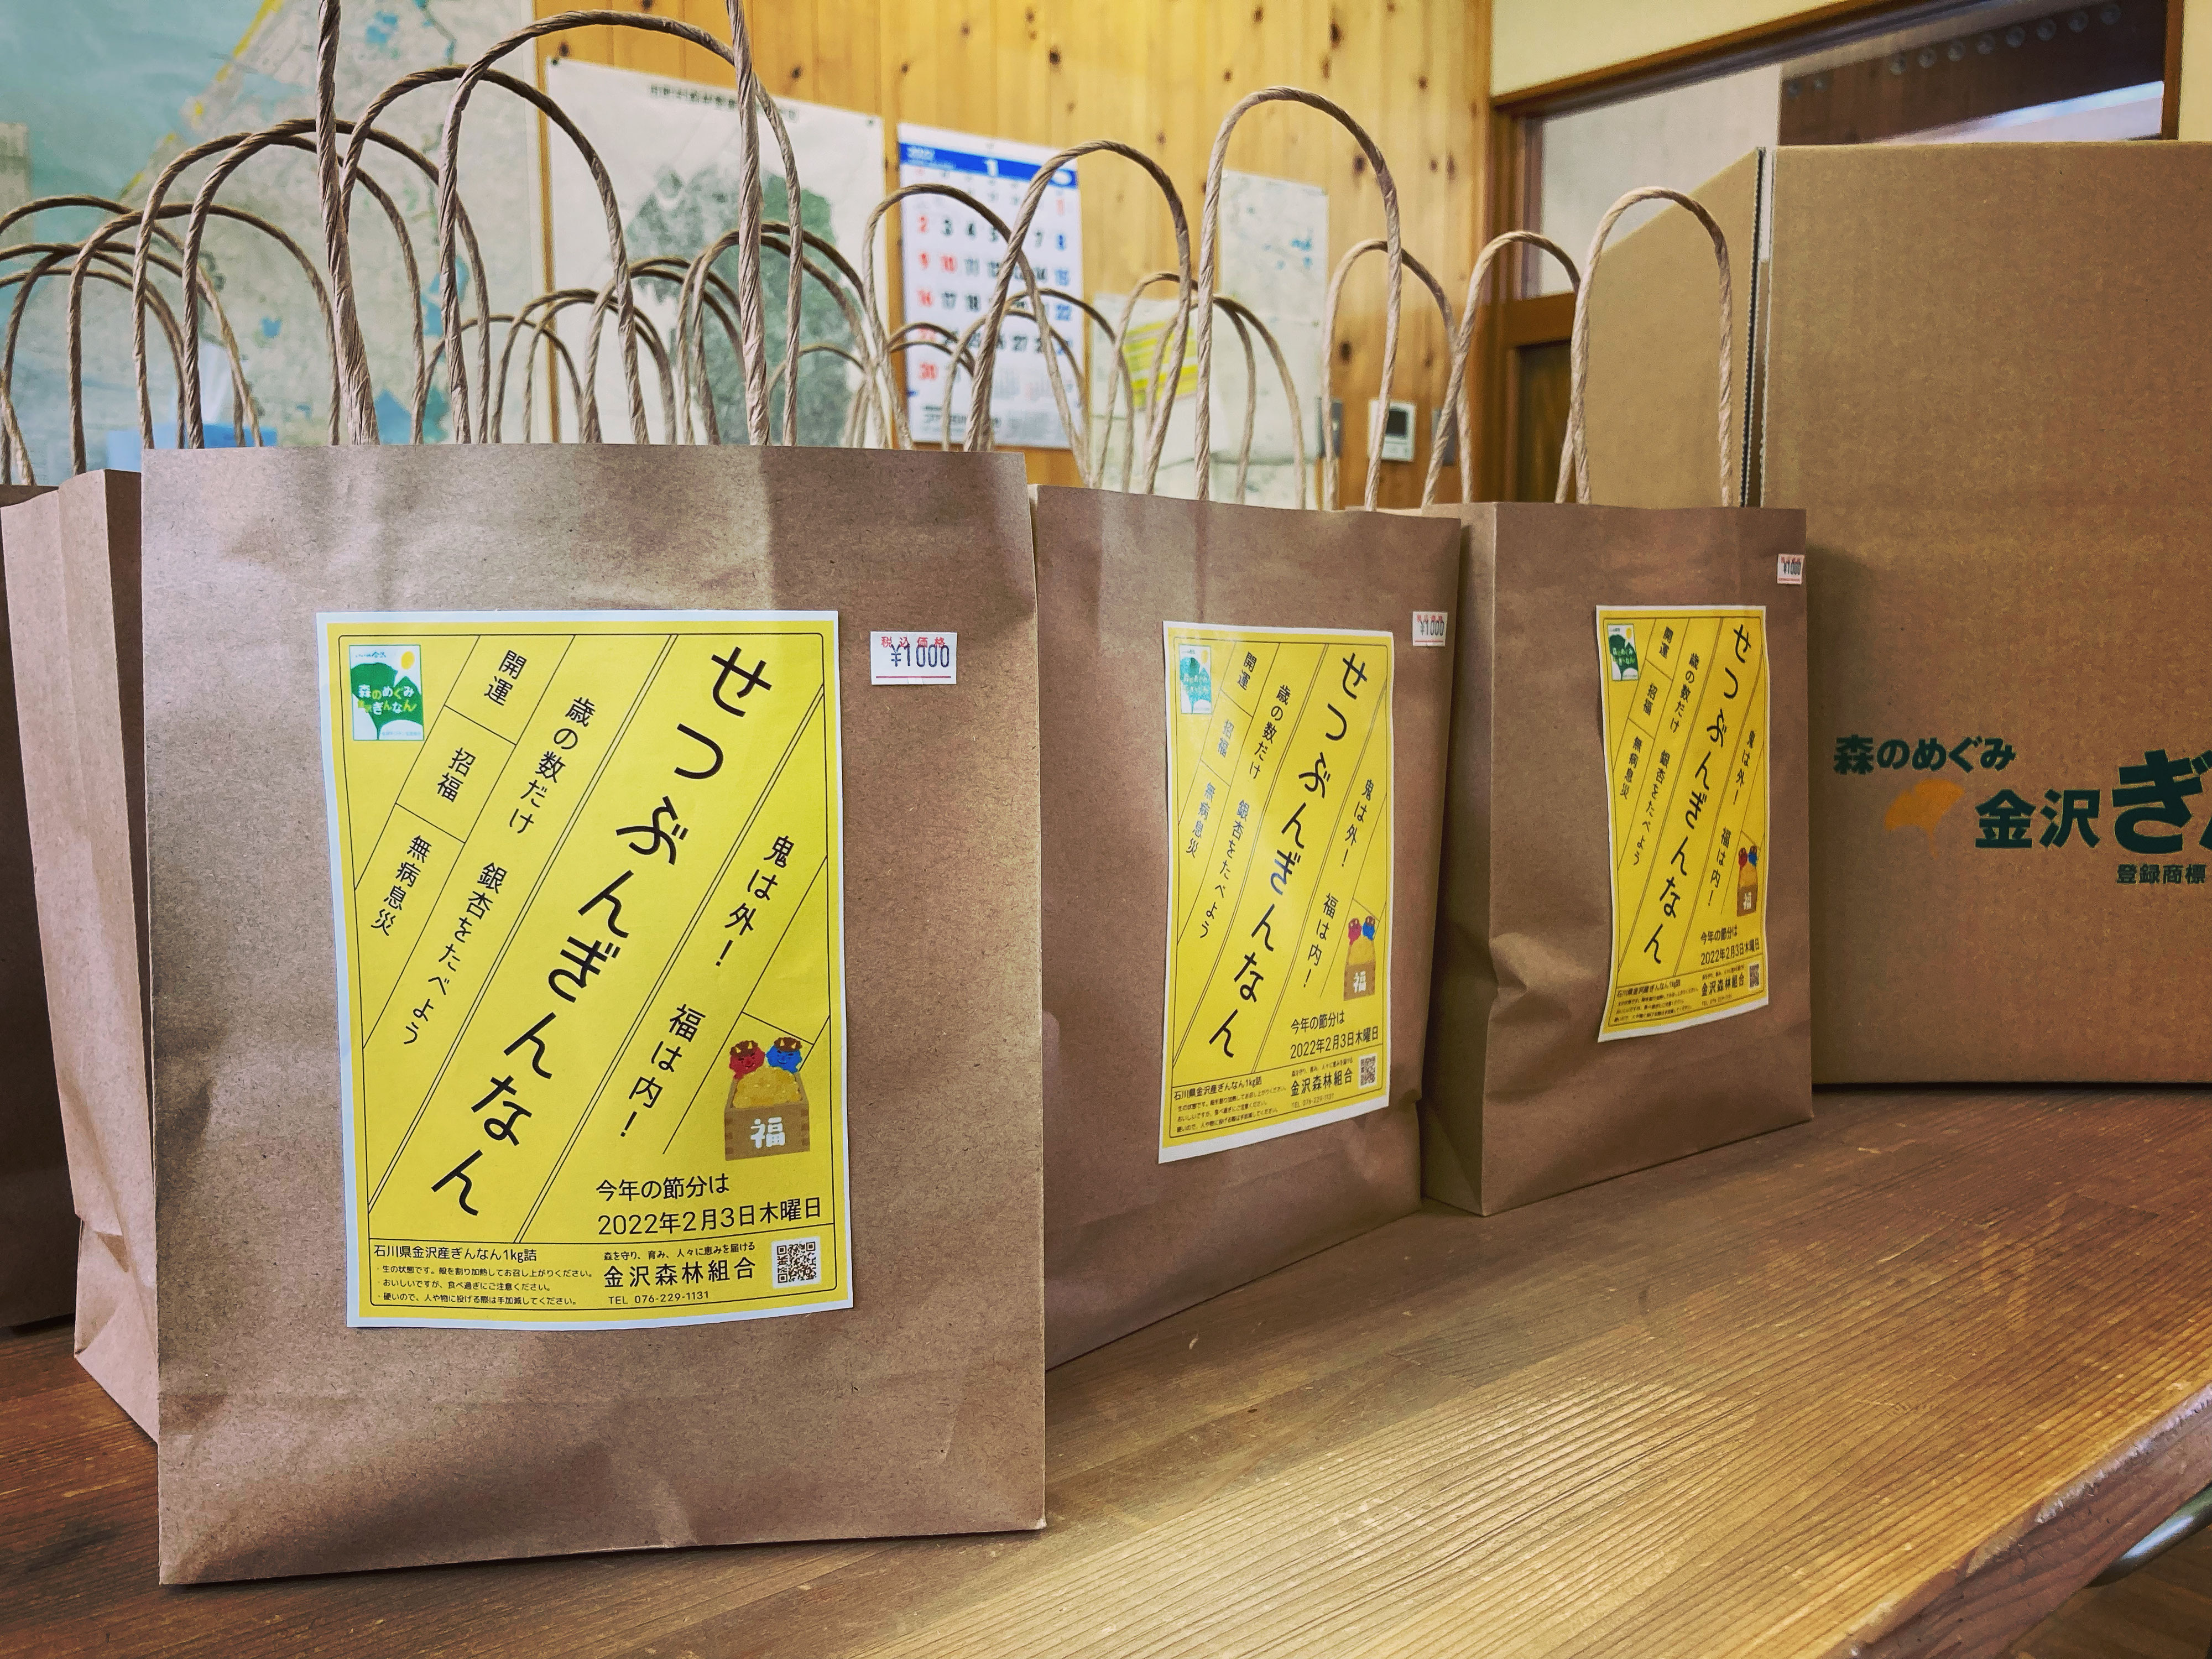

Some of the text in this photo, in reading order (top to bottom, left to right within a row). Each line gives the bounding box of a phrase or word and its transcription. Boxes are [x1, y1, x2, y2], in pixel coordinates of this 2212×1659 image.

[881, 637, 945, 648] 税込価格
[1420, 620, 1444, 636] ¥1000
[891, 644, 950, 667] ¥1000
[1238, 651, 1256, 690] 開運
[484, 650, 526, 706] 開運
[1834, 734, 2016, 774] 森のめぐみ
[437, 748, 476, 803] 招福
[1644, 624, 1751, 964] せつぶんぎんなん
[1200, 685, 1291, 938] 歳の数だけ 銀杏をたべよう
[1975, 749, 2212, 854] 金沢ぎ
[404, 697, 596, 1045] 歳の数だけ 銀杏をたべよう
[1209, 653, 1367, 1057] せつぶんぎんなん
[2116, 863, 2206, 884] 登録商標
[371, 836, 432, 936] 無病息災
[431, 647, 771, 1216] せつぶんぎんなん
[620, 836, 794, 1137] 鬼は外！ 福は内！
[1291, 1010, 1345, 1035] 今年の節分は
[1290, 1026, 1379, 1059] 2022年2月3日木曜日
[1291, 1068, 1353, 1097] 金沢森林組合
[750, 1117, 786, 1147] 福
[596, 1173, 729, 1201] 今年の節分は
[598, 1197, 820, 1235] 2022年2月3日木曜日
[374, 1245, 537, 1263] 石川県金沢産ぎんなん1kg詰
[604, 1257, 756, 1288] 金沢森林組合
[608, 1291, 709, 1305] TEL 076-229-1131
